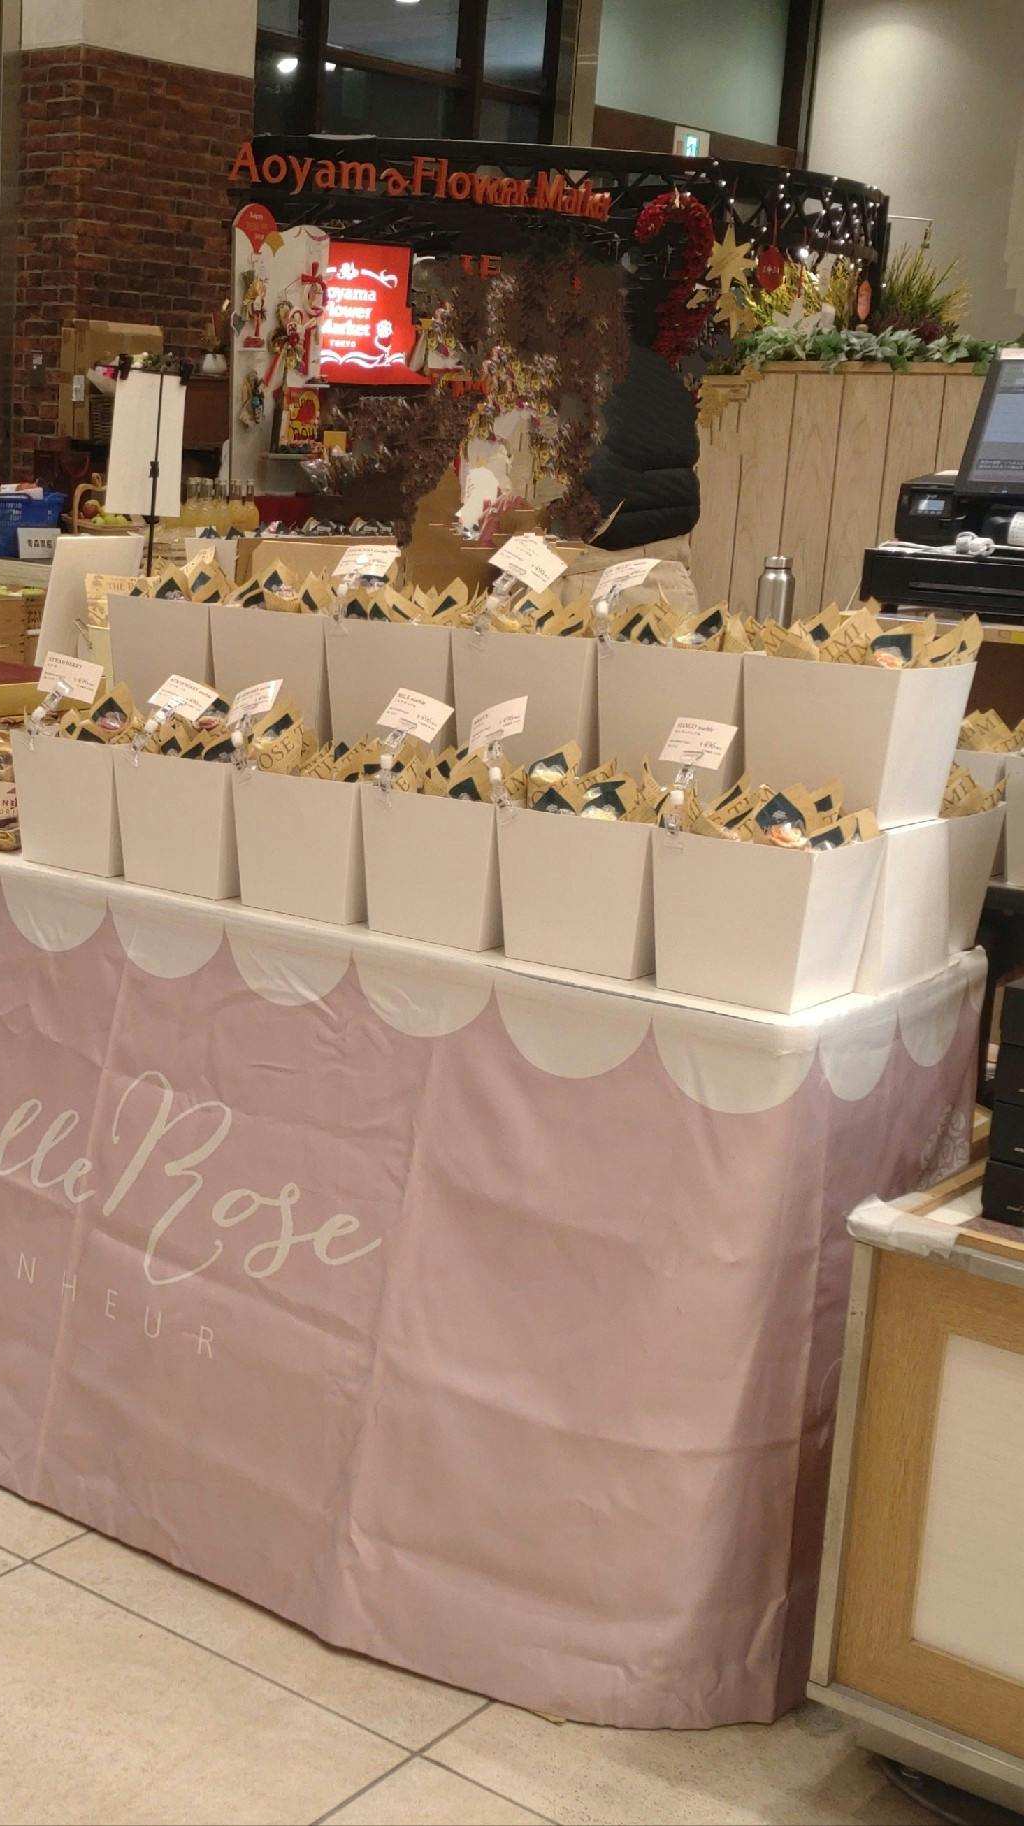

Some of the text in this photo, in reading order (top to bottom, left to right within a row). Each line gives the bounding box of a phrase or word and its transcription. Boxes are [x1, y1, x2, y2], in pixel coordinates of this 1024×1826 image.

[227, 141, 408, 197] Aoyama
[326, 286, 377, 302] oyama
[102, 1070, 383, 1286] Rose
